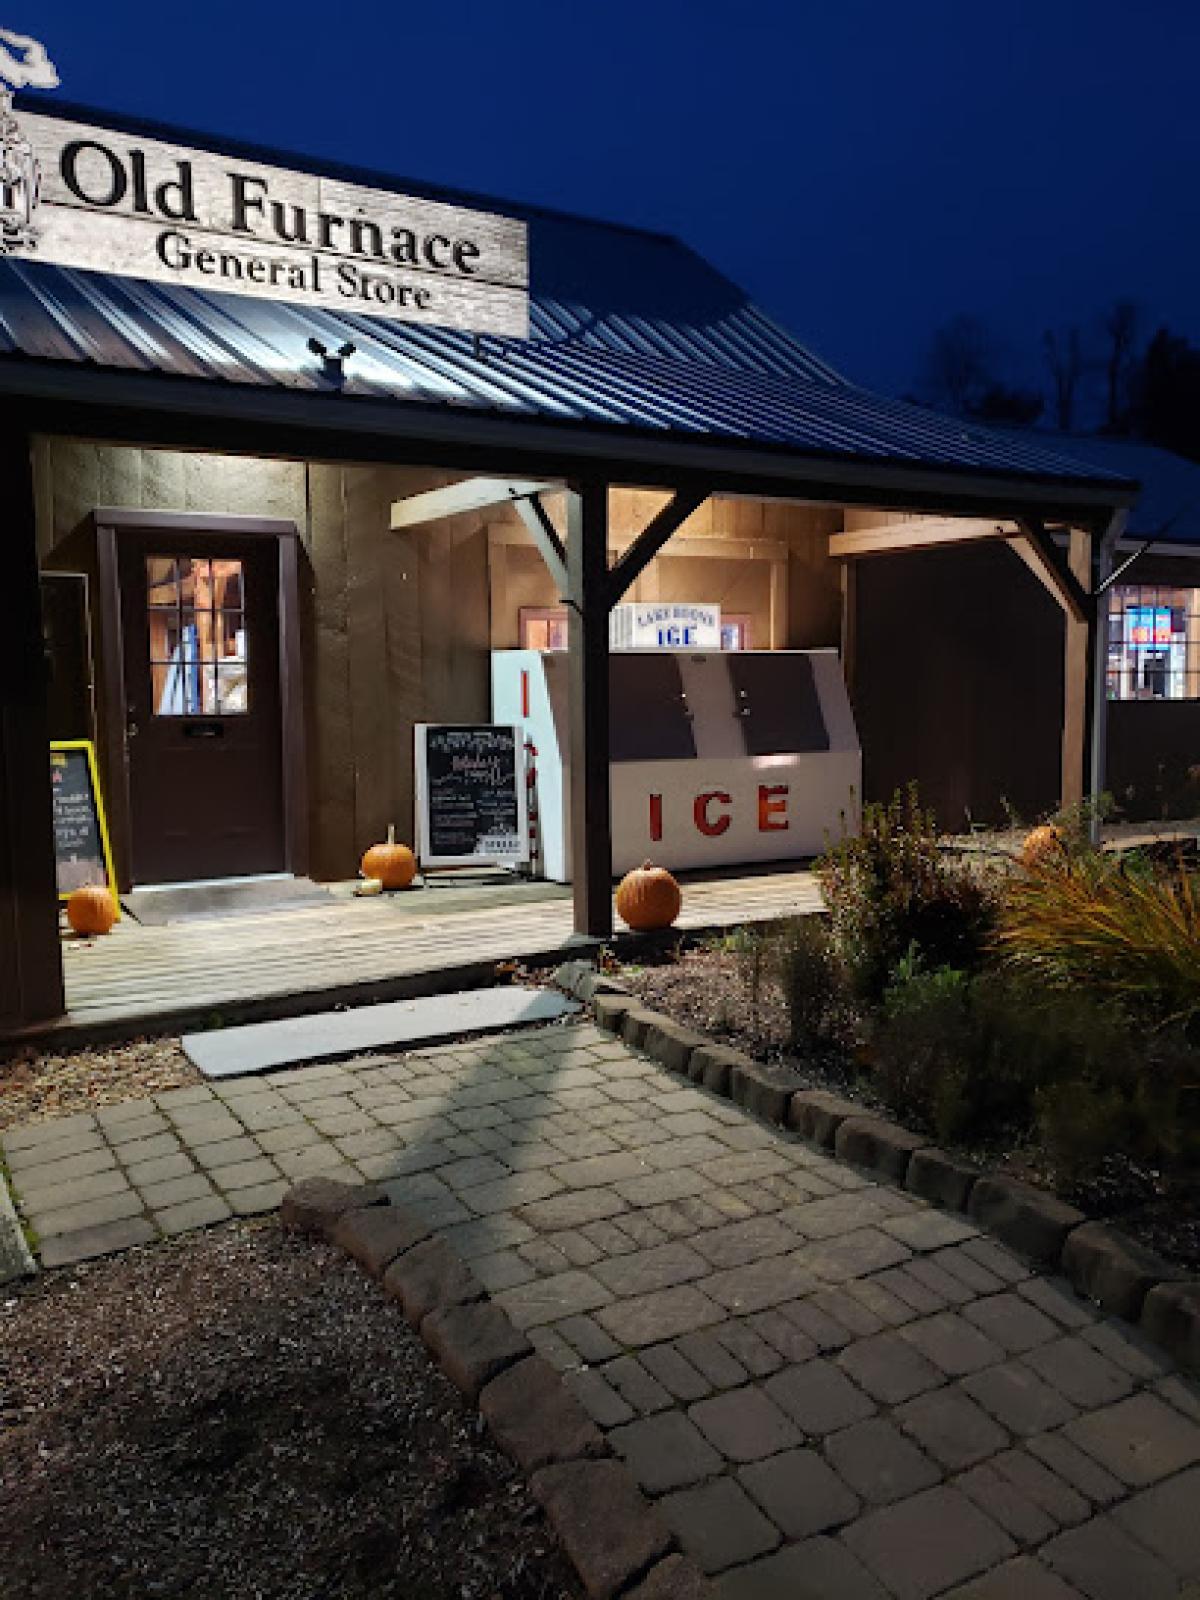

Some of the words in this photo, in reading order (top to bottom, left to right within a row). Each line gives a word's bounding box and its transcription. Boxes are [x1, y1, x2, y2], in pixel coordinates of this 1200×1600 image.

[60, 140, 197, 222] Old
[227, 172, 480, 274] Furnace
[156, 231, 322, 292] General
[338, 264, 433, 310] Store
[658, 624, 697, 646] ICE
[649, 784, 790, 842] ICE
